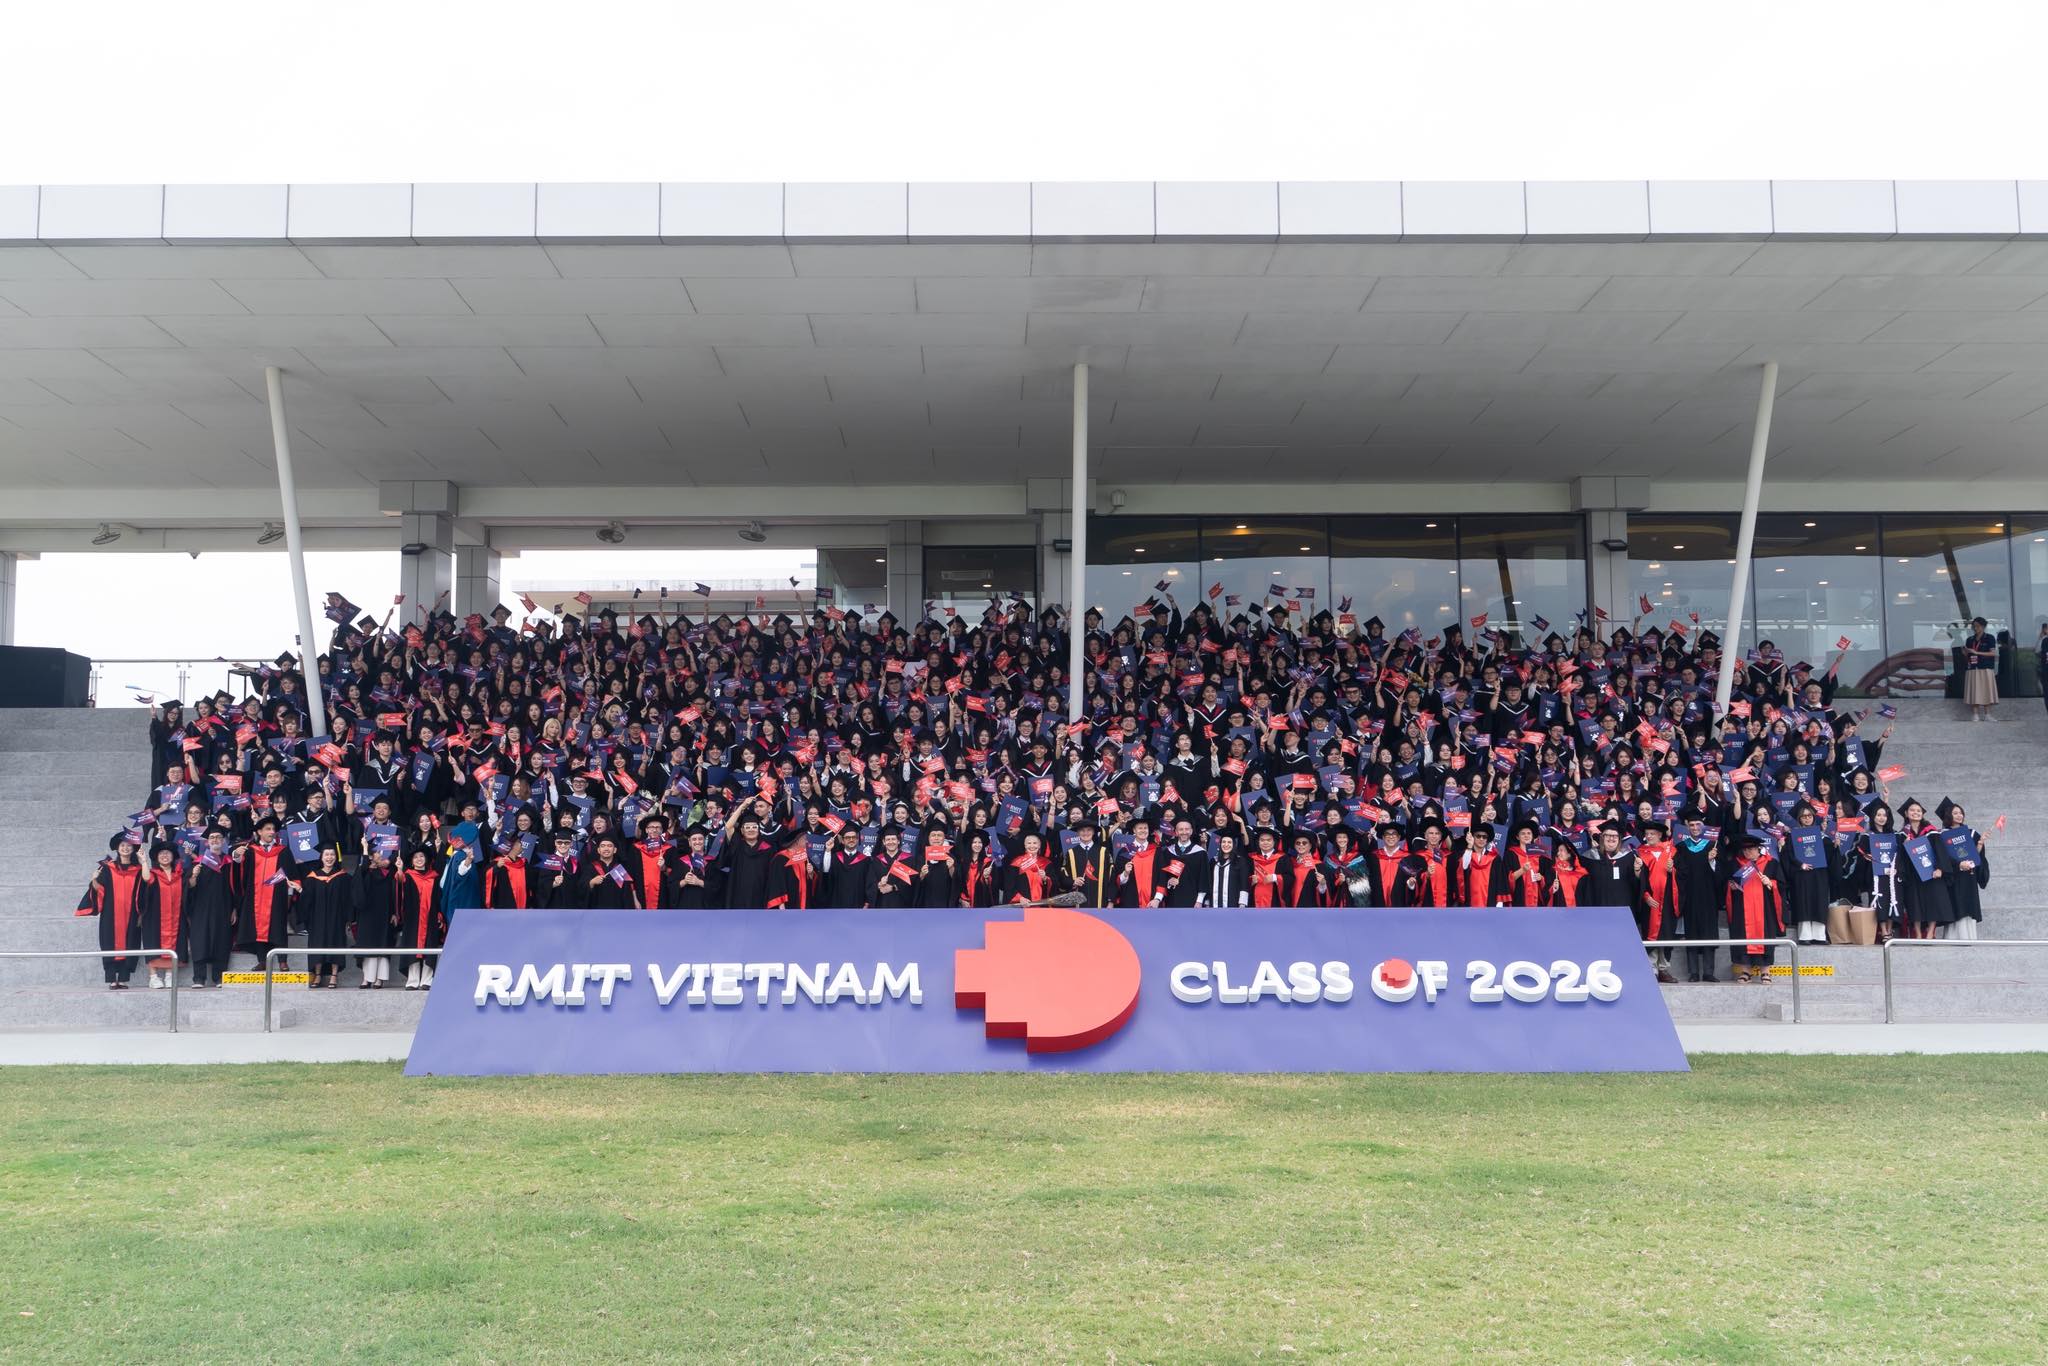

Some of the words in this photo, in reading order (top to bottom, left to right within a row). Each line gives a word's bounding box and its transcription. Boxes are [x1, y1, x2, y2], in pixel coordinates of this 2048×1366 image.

[1010, 805, 1022, 813] RMIT
[1952, 835, 1966, 843] RMIT
[182, 841, 197, 849] RMIT
[474, 964, 631, 1005] RMIT
[648, 963, 922, 1005] VIETNAM
[1170, 961, 1353, 1003] CLASS
[1371, 959, 1448, 1002] OF
[1466, 960, 1622, 1002] 2026
